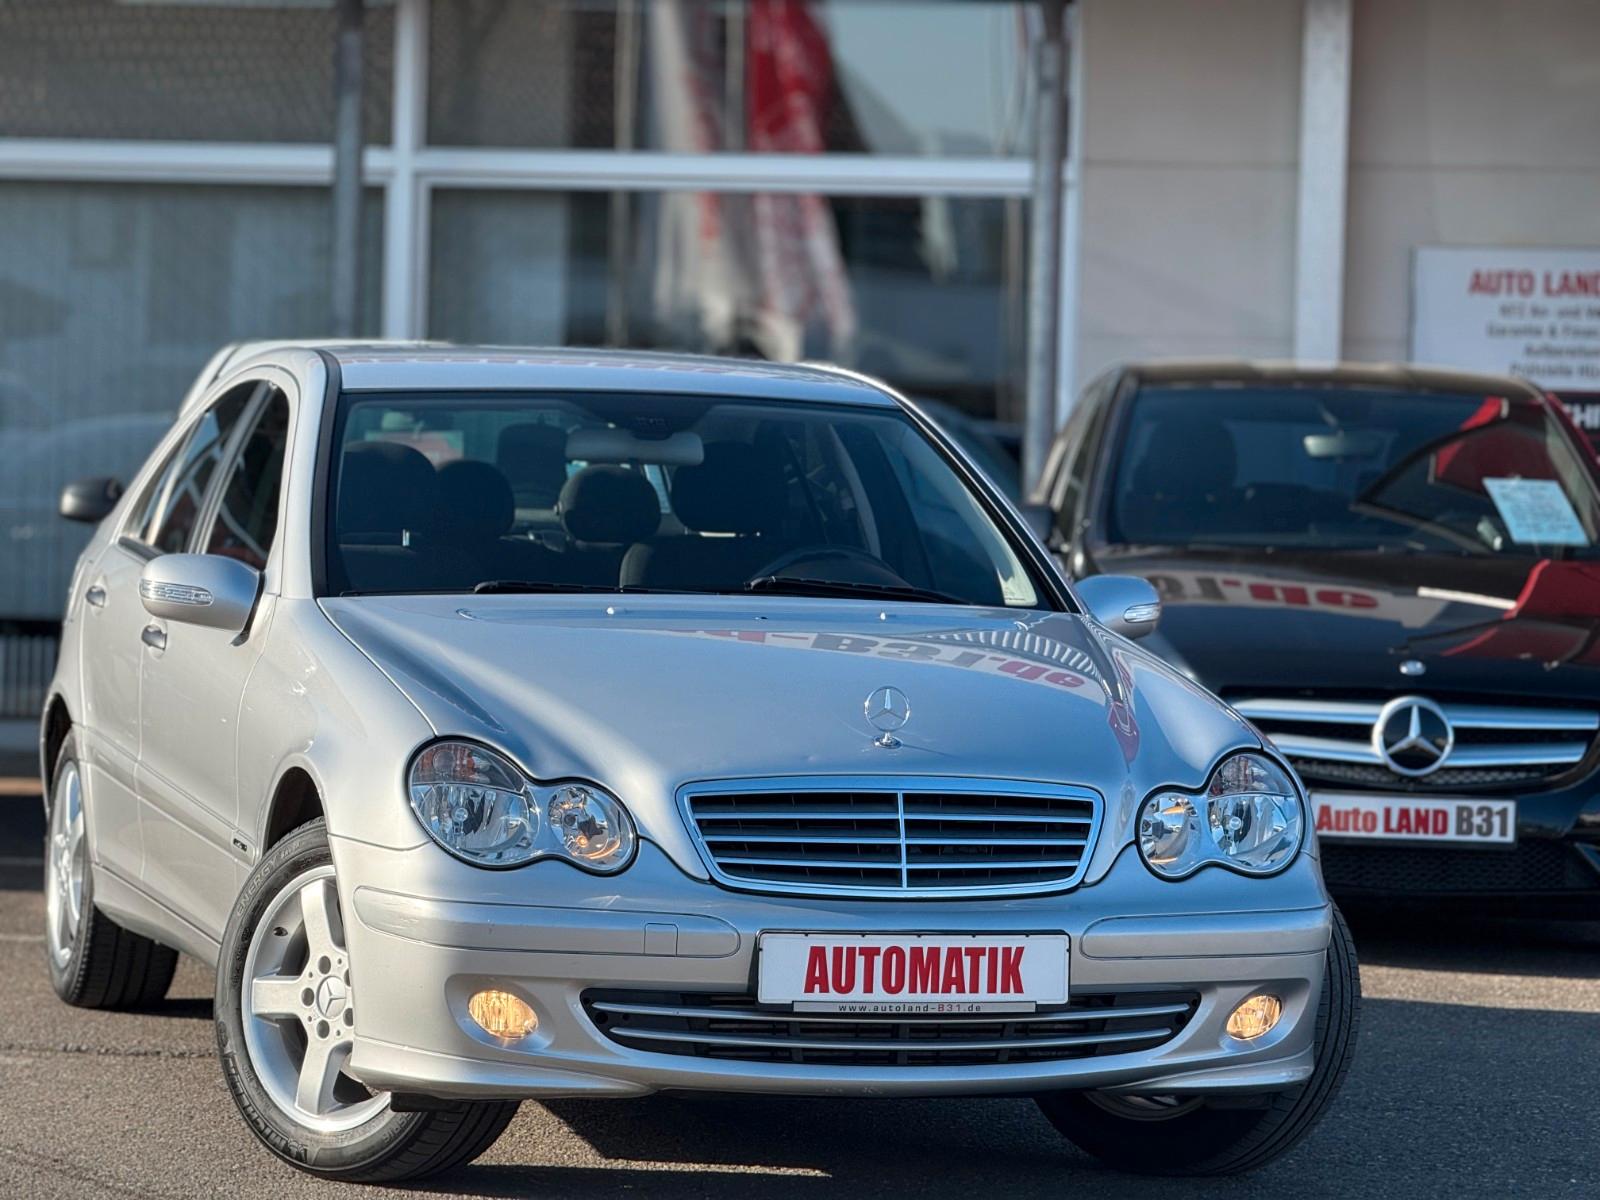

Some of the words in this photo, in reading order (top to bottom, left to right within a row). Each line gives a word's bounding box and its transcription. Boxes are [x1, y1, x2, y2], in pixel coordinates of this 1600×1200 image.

[1469, 270, 1535, 296] AUTO
[1316, 804, 1377, 833] Auto
[1384, 806, 1448, 835] LAND
[1455, 805, 1509, 838] B31
[803, 945, 1026, 995] AUTOMATIK
[838, 1003, 982, 1012] www.autoland-B31.de
